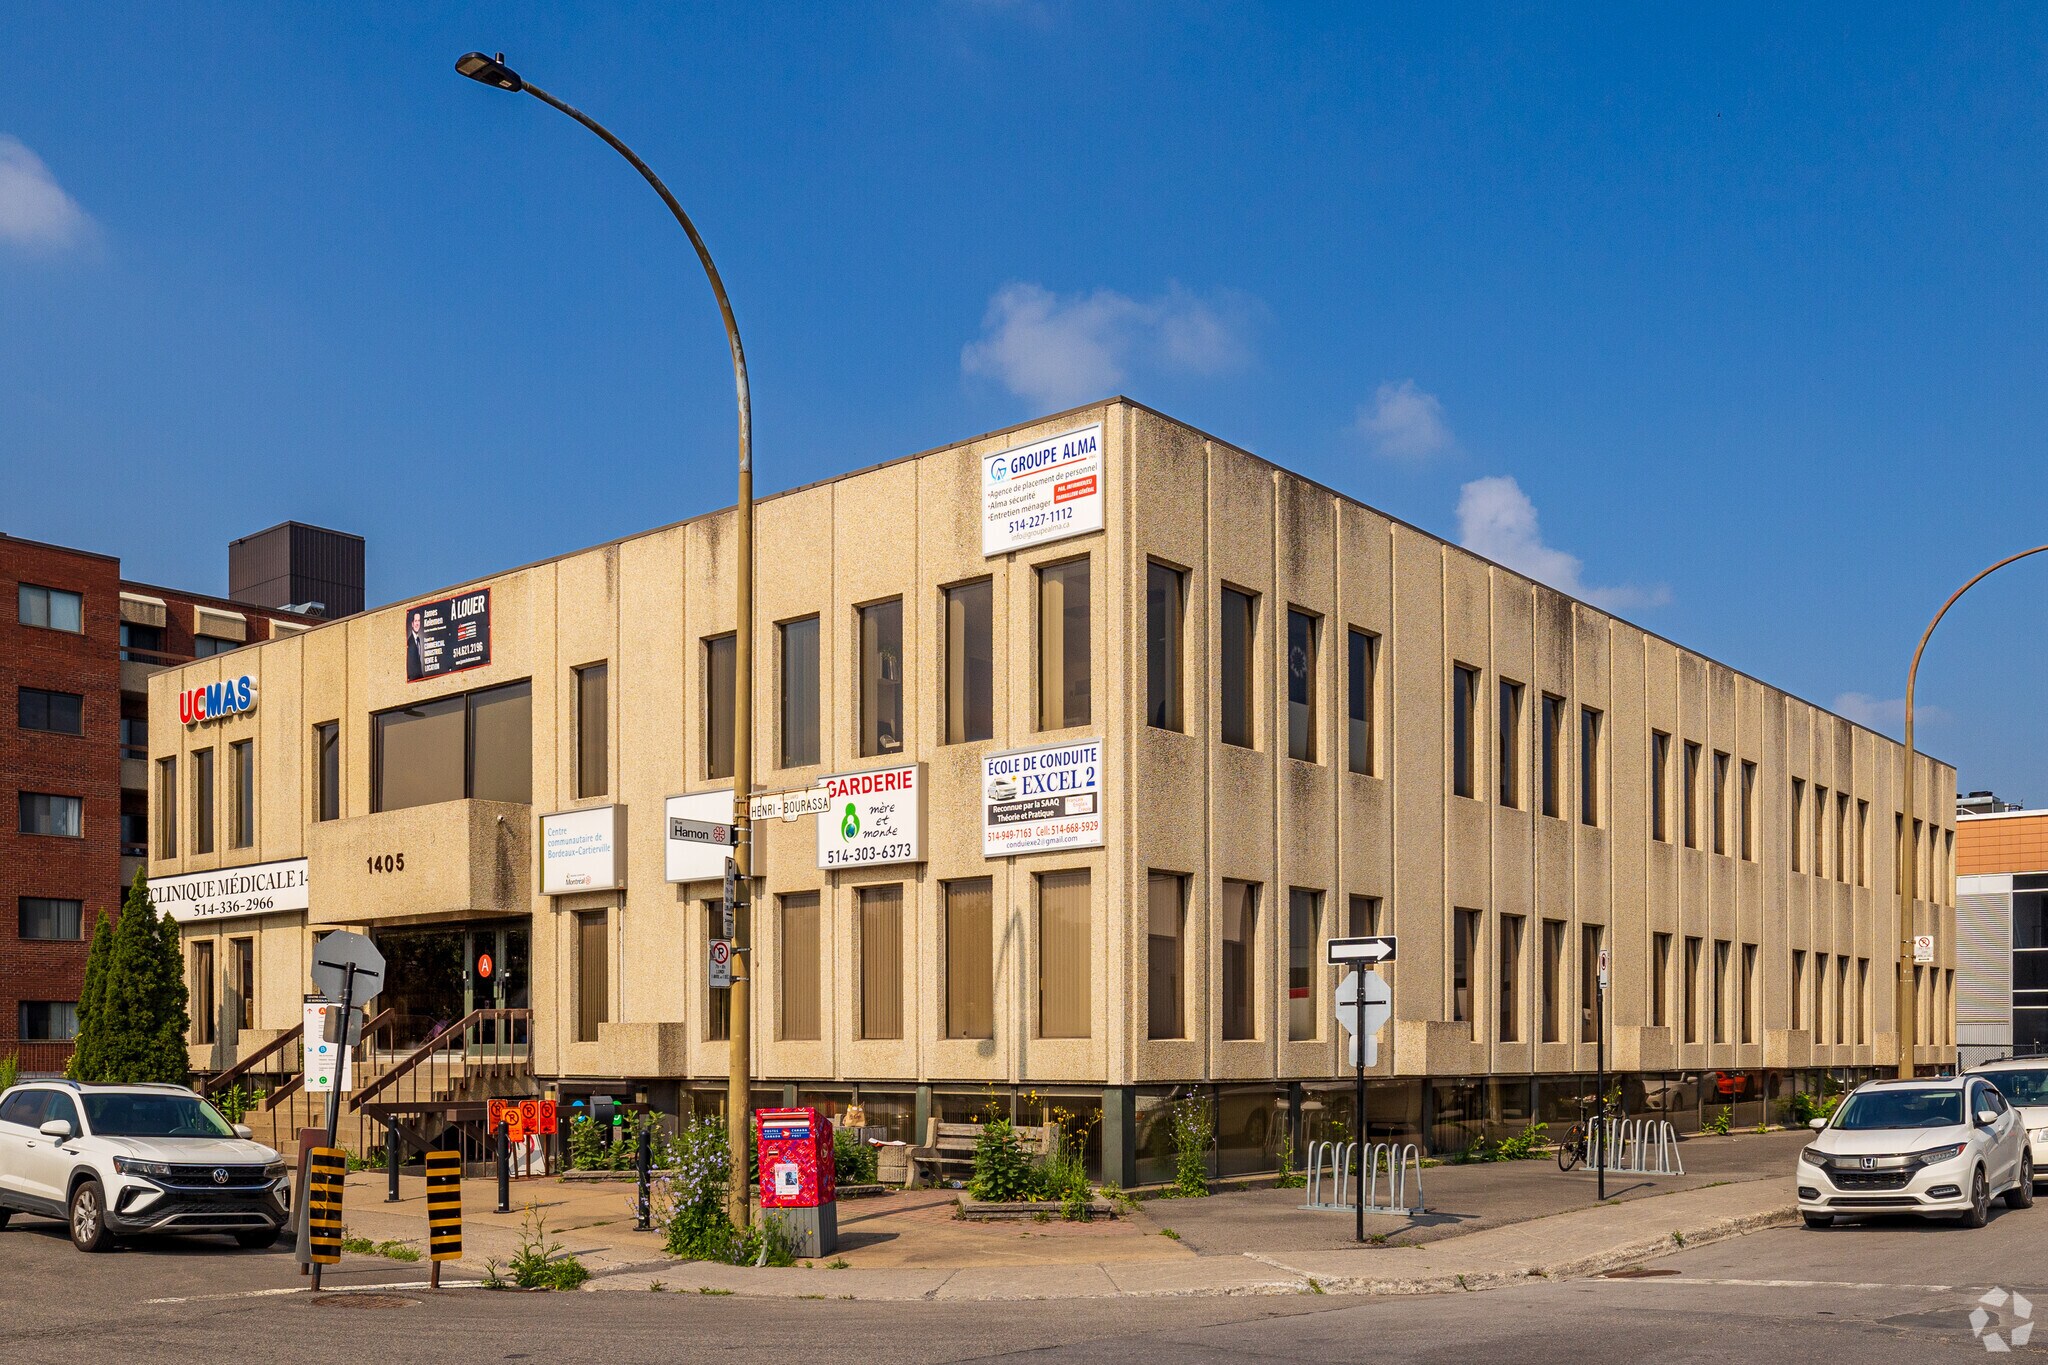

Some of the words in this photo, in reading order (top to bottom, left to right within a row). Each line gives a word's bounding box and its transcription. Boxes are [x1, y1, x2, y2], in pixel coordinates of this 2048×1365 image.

[1011, 446, 1056, 473] GROUPE
[1063, 436, 1096, 460] ALMA
[1014, 484, 1021, 492] de
[1022, 474, 1054, 491] placement
[1056, 472, 1064, 480] de
[1065, 462, 1098, 479] personnel
[1009, 491, 1036, 505] sécurité
[990, 508, 1020, 522] Entretien
[1009, 507, 1072, 534] 514-227-1112
[451, 599, 457, 620] À
[457, 595, 484, 618] LOUER
[180, 675, 250, 724] UCMAS
[988, 758, 1019, 776] ÉCOLE
[1024, 756, 1036, 771] DE
[1040, 748, 1096, 768] CONDUITE
[827, 770, 912, 798] GARDERIE
[1022, 770, 1081, 795] EXCEL
[1086, 766, 1095, 786] 2
[869, 802, 895, 814] mère
[993, 804, 1022, 813] Reconnue
[1023, 802, 1034, 810] par
[1041, 798, 1060, 807] SAAQ
[876, 815, 889, 826] et
[997, 812, 1020, 822] Théorie
[1028, 810, 1054, 818] Pratique
[548, 828, 567, 836] Centre
[548, 834, 593, 847] communautaire
[595, 833, 602, 841] de
[674, 826, 709, 840] Hamon
[862, 826, 898, 838] monde
[988, 828, 1032, 842] 514-949-7163
[1052, 821, 1098, 835] 514-668-5929
[548, 844, 610, 858] Bordeaux-Cartierville
[828, 843, 911, 864] 514-303-6373
[366, 853, 404, 874] 1405
[150, 880, 216, 904] CLINIQUE
[218, 870, 296, 896] MÉDICALE
[194, 896, 274, 916] 514-336-2966
[482, 958, 489, 972] A
